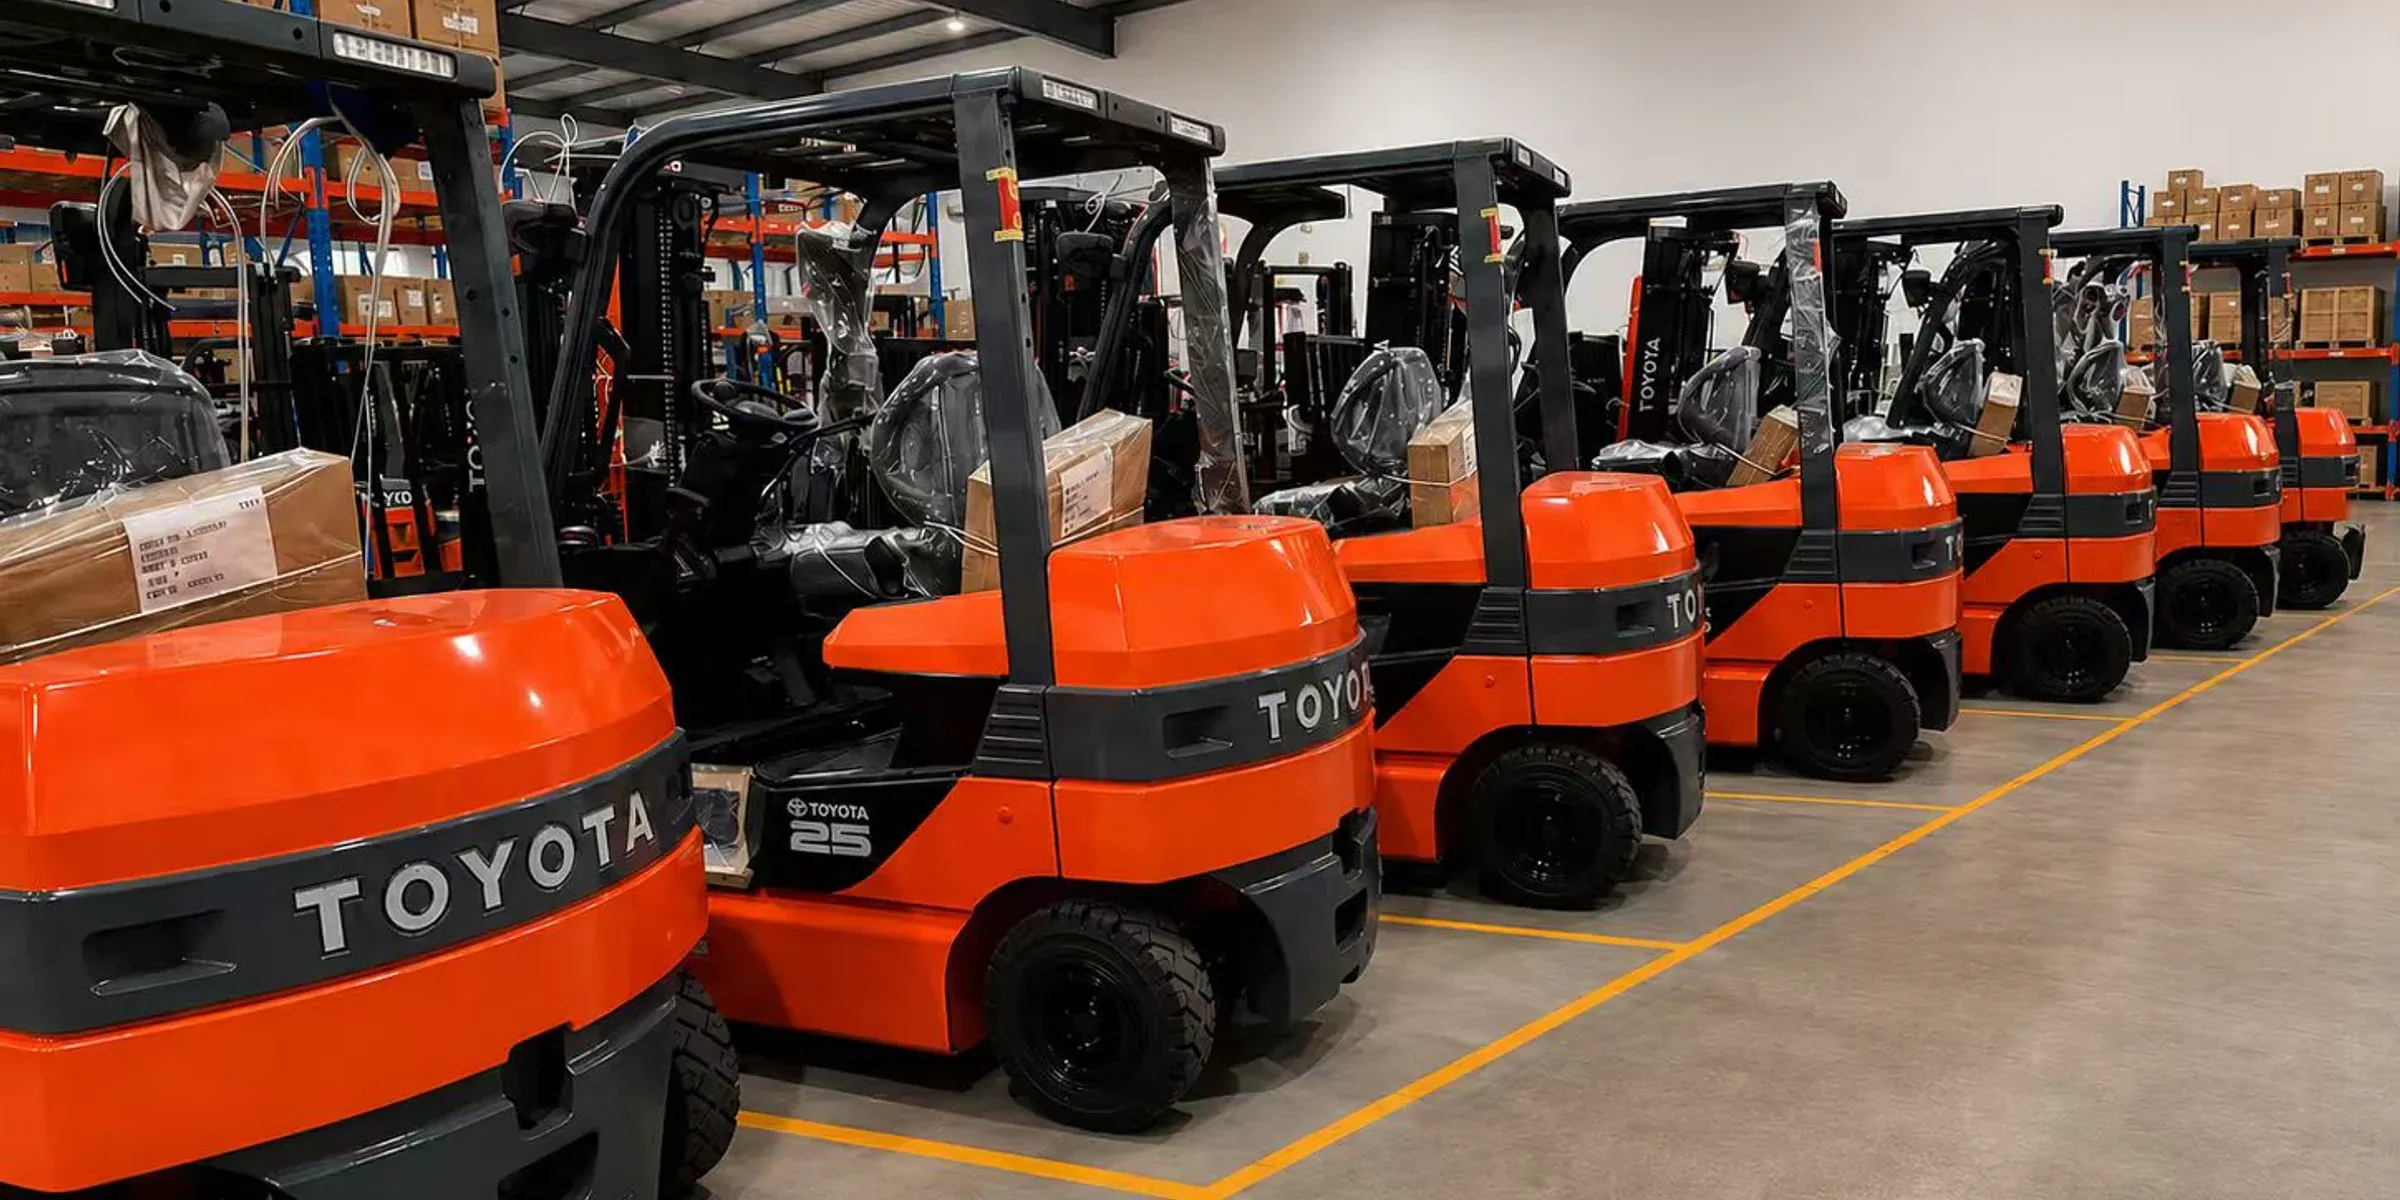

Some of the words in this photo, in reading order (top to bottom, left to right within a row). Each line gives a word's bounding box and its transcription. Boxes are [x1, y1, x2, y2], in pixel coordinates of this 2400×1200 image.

[808, 802, 870, 820] TOYOTA
[790, 820, 872, 857] 25
[294, 789, 655, 952] TOYOTA
